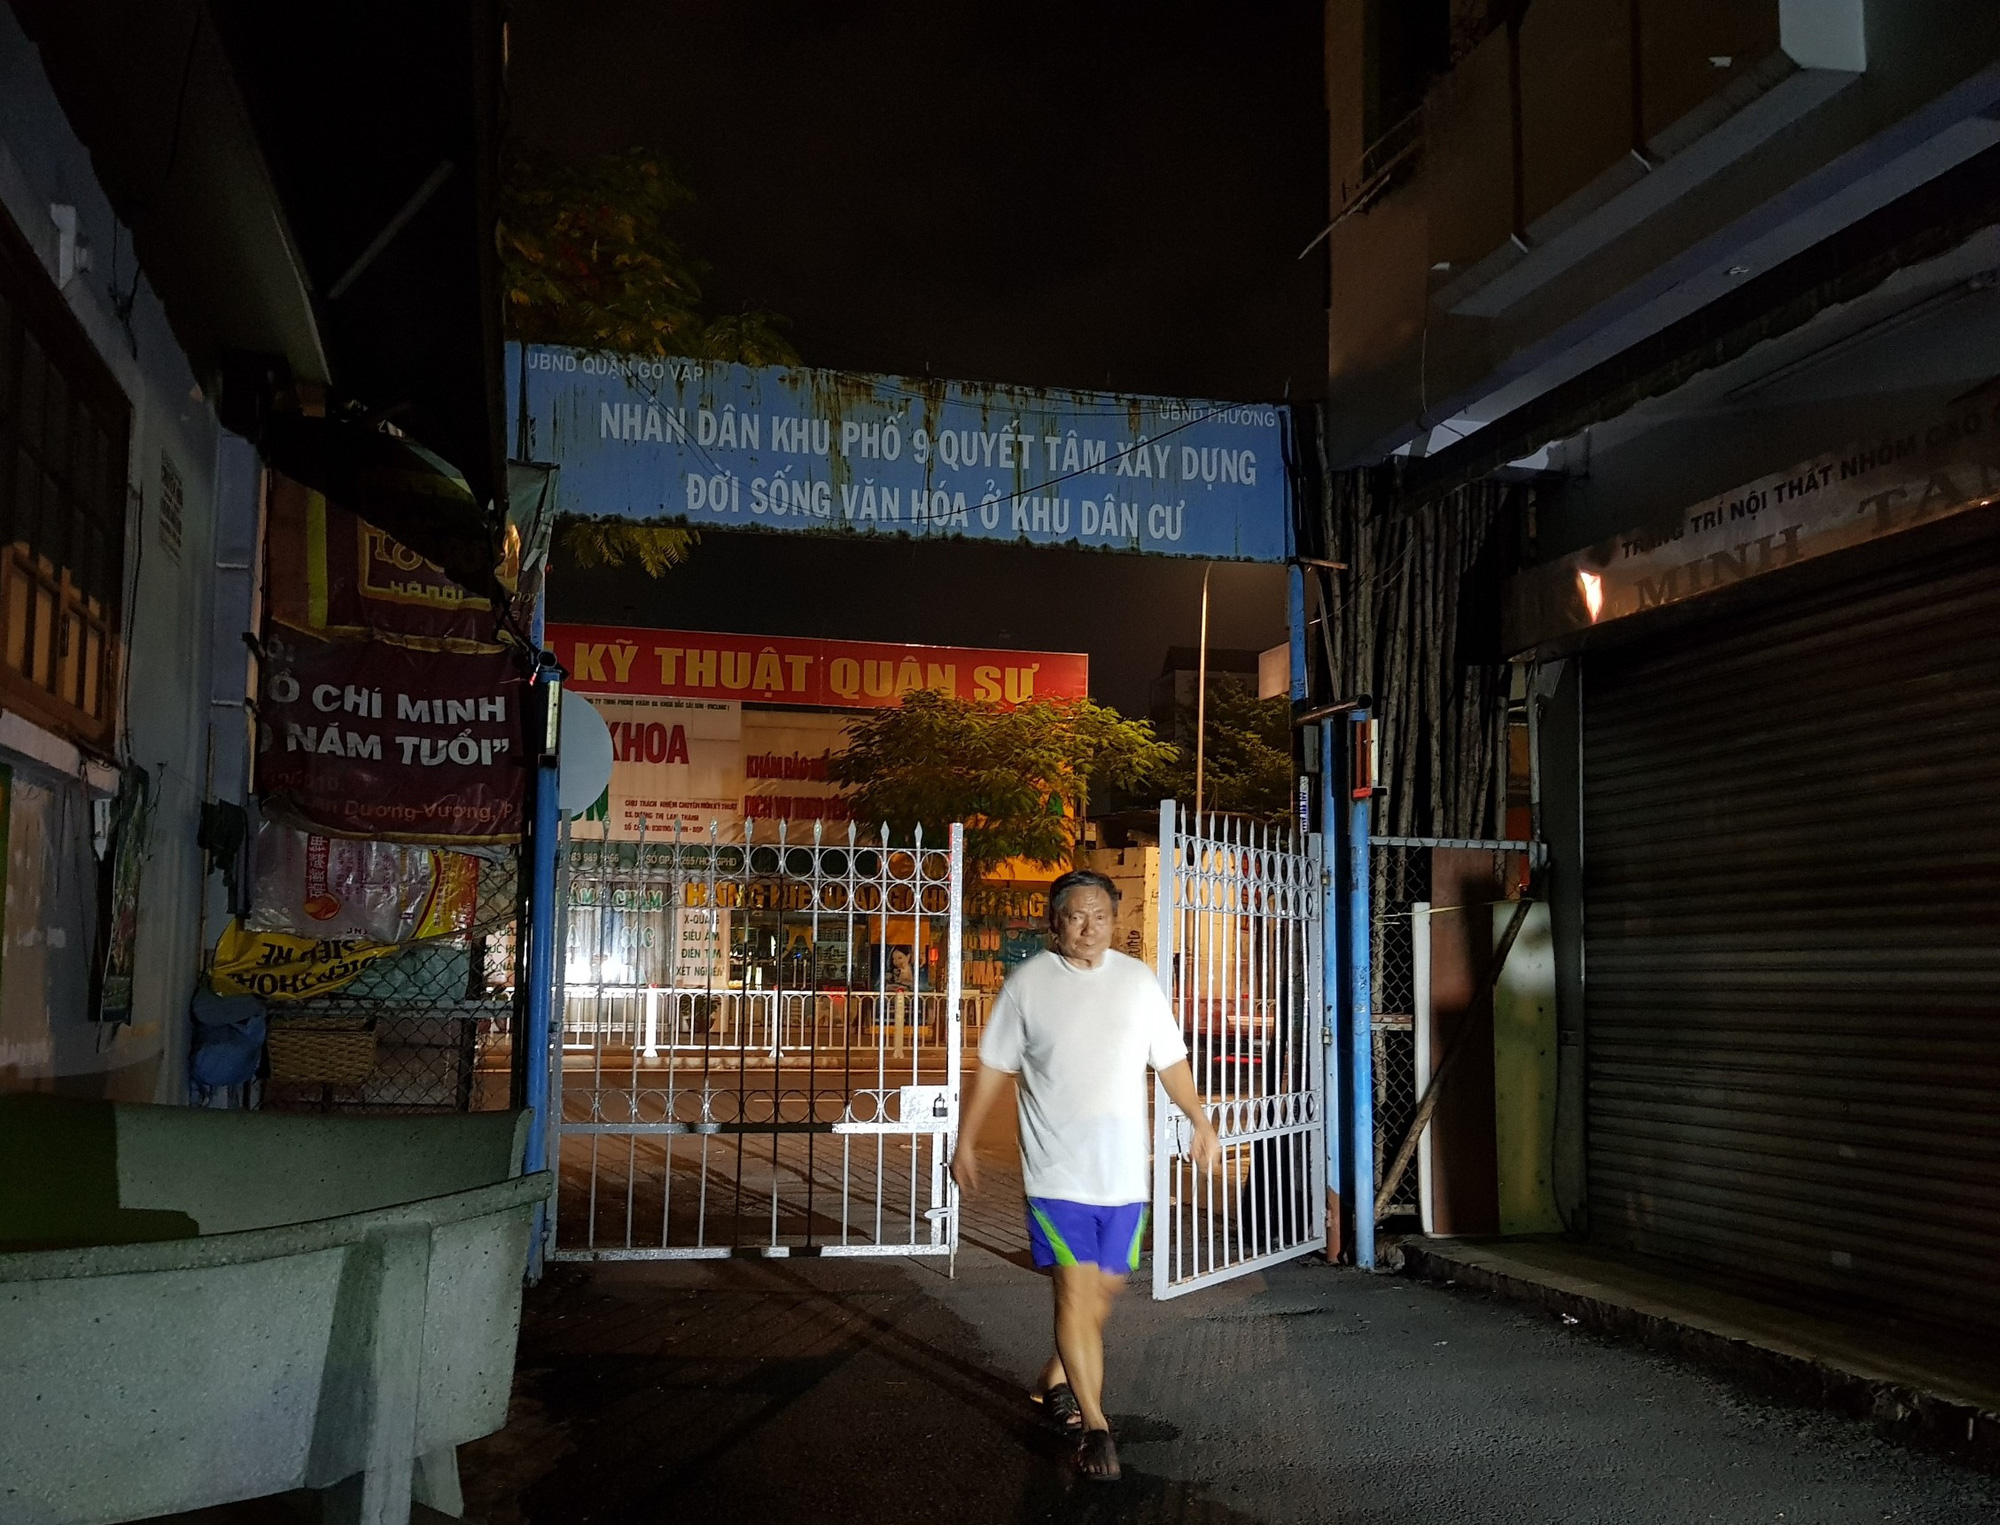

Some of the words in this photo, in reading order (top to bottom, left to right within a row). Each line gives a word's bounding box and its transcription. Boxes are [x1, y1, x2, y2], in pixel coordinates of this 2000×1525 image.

[528, 353, 577, 372] UBND
[582, 356, 632, 379] QUẬN
[1160, 403, 1203, 421] UBND
[600, 397, 686, 444] NHÂN
[699, 403, 760, 450] DÂN
[772, 416, 830, 455] KHU
[842, 411, 905, 461] PHỐ
[913, 428, 929, 464] 9
[939, 420, 1035, 471] QUYẾT
[1044, 430, 1106, 475] TÂM
[1116, 435, 1170, 479] XÂY
[1182, 446, 1257, 490] DỰNG
[686, 463, 740, 513] ĐỜI
[751, 464, 832, 520] SỐNG
[841, 478, 900, 523] VĂN
[911, 480, 969, 528] HÓA
[981, 479, 1002, 530] Ở
[1011, 495, 1070, 535] KHU
[1082, 494, 1139, 539] DÂN
[1148, 499, 1186, 541] CƯ
[1690, 501, 1724, 533] TRÍ
[1730, 490, 1767, 521] NỘI
[1773, 461, 1834, 504] THẤT
[1634, 524, 1804, 610] MINH
[574, 639, 639, 683] KỸ
[654, 647, 814, 698] THUẬT
[830, 655, 956, 700] QUÂN
[312, 684, 383, 719] CHÍ
[397, 693, 506, 725] MINH
[287, 722, 383, 760] NĂM
